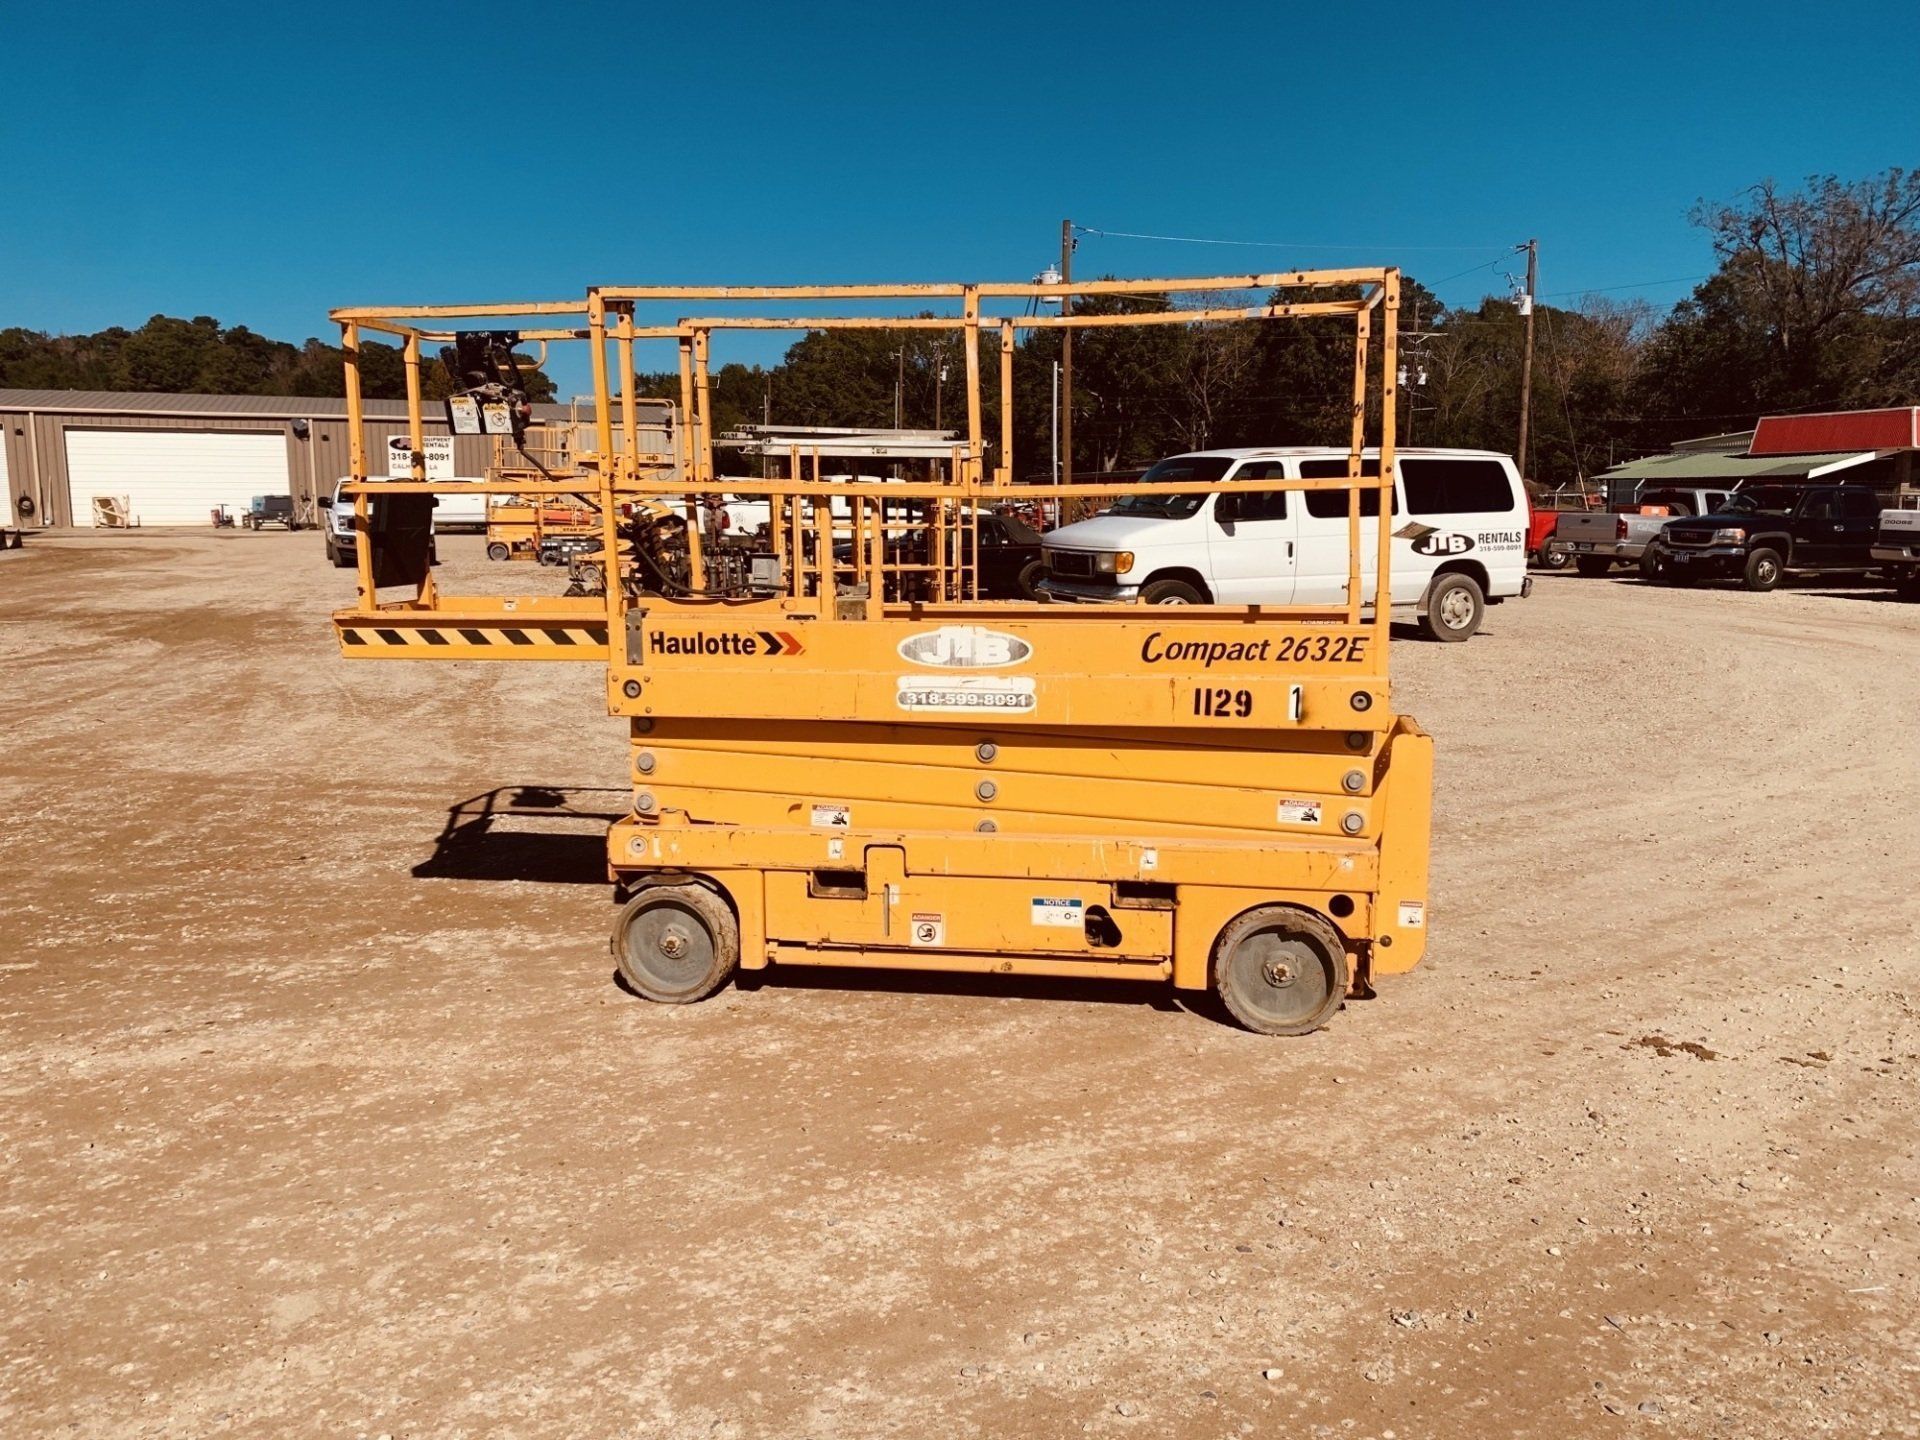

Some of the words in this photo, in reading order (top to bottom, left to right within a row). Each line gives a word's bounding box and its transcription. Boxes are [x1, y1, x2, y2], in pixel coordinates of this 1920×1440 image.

[391, 452, 449, 460] 318--8091
[1478, 531, 1521, 544] RENTALS
[650, 631, 757, 655] Haulotte
[1141, 632, 1271, 667] Compact
[1275, 636, 1370, 662] 2632E
[906, 691, 1027, 706] 318-599-8091
[1193, 687, 1253, 717] 1129
